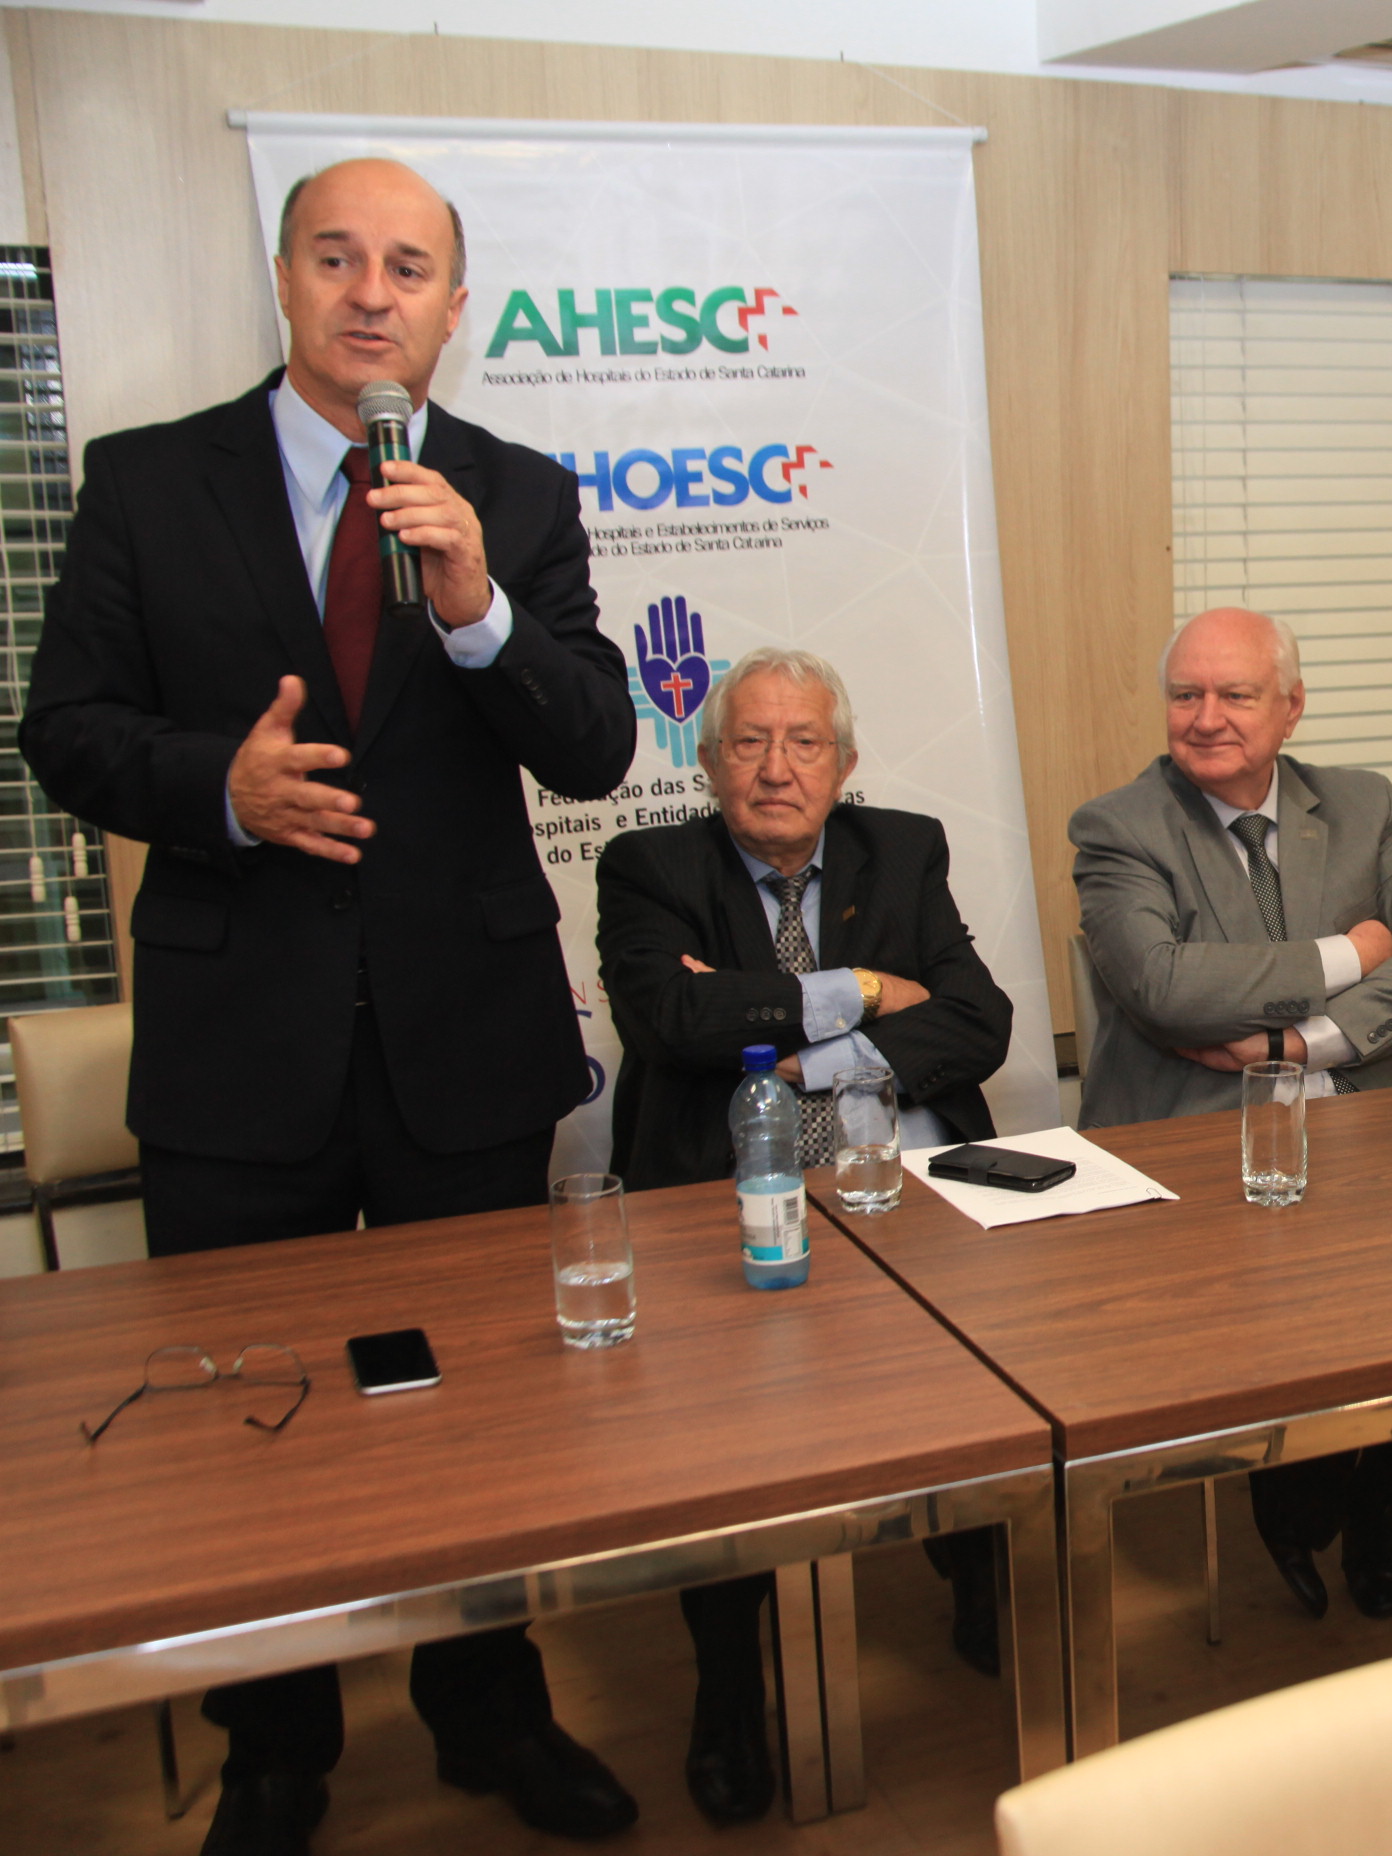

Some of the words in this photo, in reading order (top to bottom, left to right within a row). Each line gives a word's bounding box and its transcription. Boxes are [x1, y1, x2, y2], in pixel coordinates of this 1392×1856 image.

[484, 285, 750, 359] AHESC
[482, 369, 553, 387] Associação
[556, 369, 573, 384] de
[576, 368, 632, 386] Hospitais
[635, 367, 651, 382] do
[655, 366, 696, 382] Estado
[700, 365, 716, 380] de
[718, 364, 754, 380] Santa
[757, 363, 806, 379] Catarina
[546, 443, 793, 513] HOESC
[587, 523, 642, 542] Hospitais
[645, 526, 654, 538] e
[657, 519, 760, 538] Estabelecimentos
[763, 518, 779, 532] de
[781, 516, 829, 533] Serviços
[611, 542, 627, 557] do
[631, 539, 673, 556] Estado
[675, 539, 692, 553] de
[694, 537, 730, 552] Santa
[732, 534, 783, 550] Catarina
[537, 781, 643, 808] Feção
[650, 777, 686, 797] das
[534, 812, 602, 841] spitais
[615, 814, 628, 829] e
[634, 800, 721, 826] Entidad
[546, 844, 573, 865] do
